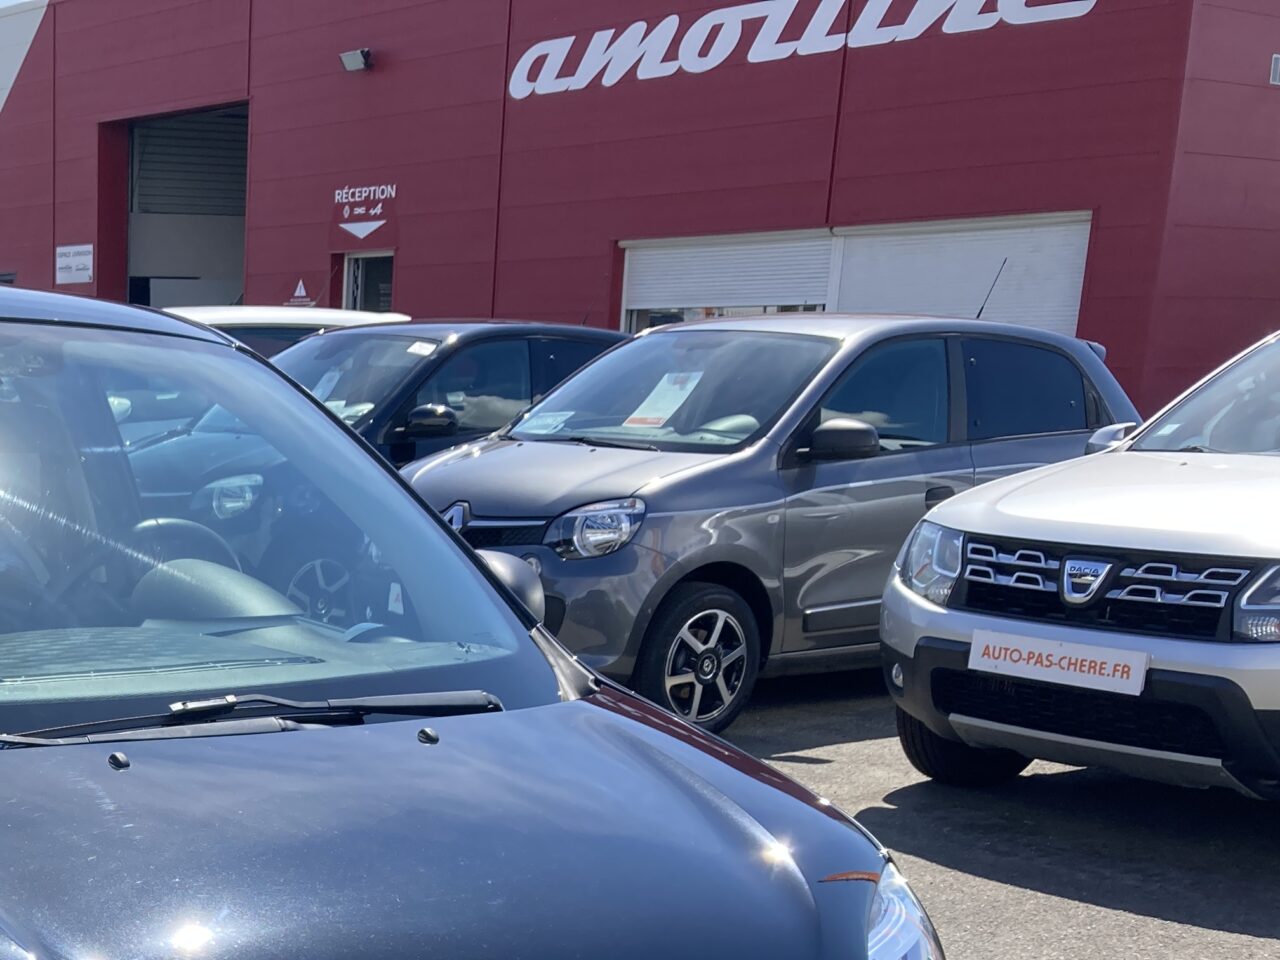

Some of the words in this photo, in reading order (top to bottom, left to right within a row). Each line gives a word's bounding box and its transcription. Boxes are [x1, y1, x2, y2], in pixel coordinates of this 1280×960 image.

[335, 184, 396, 203] RÉCEPTION
[1069, 566, 1099, 574] DACIA
[981, 644, 1131, 680] AUTO-PAS-CHERE.FR
